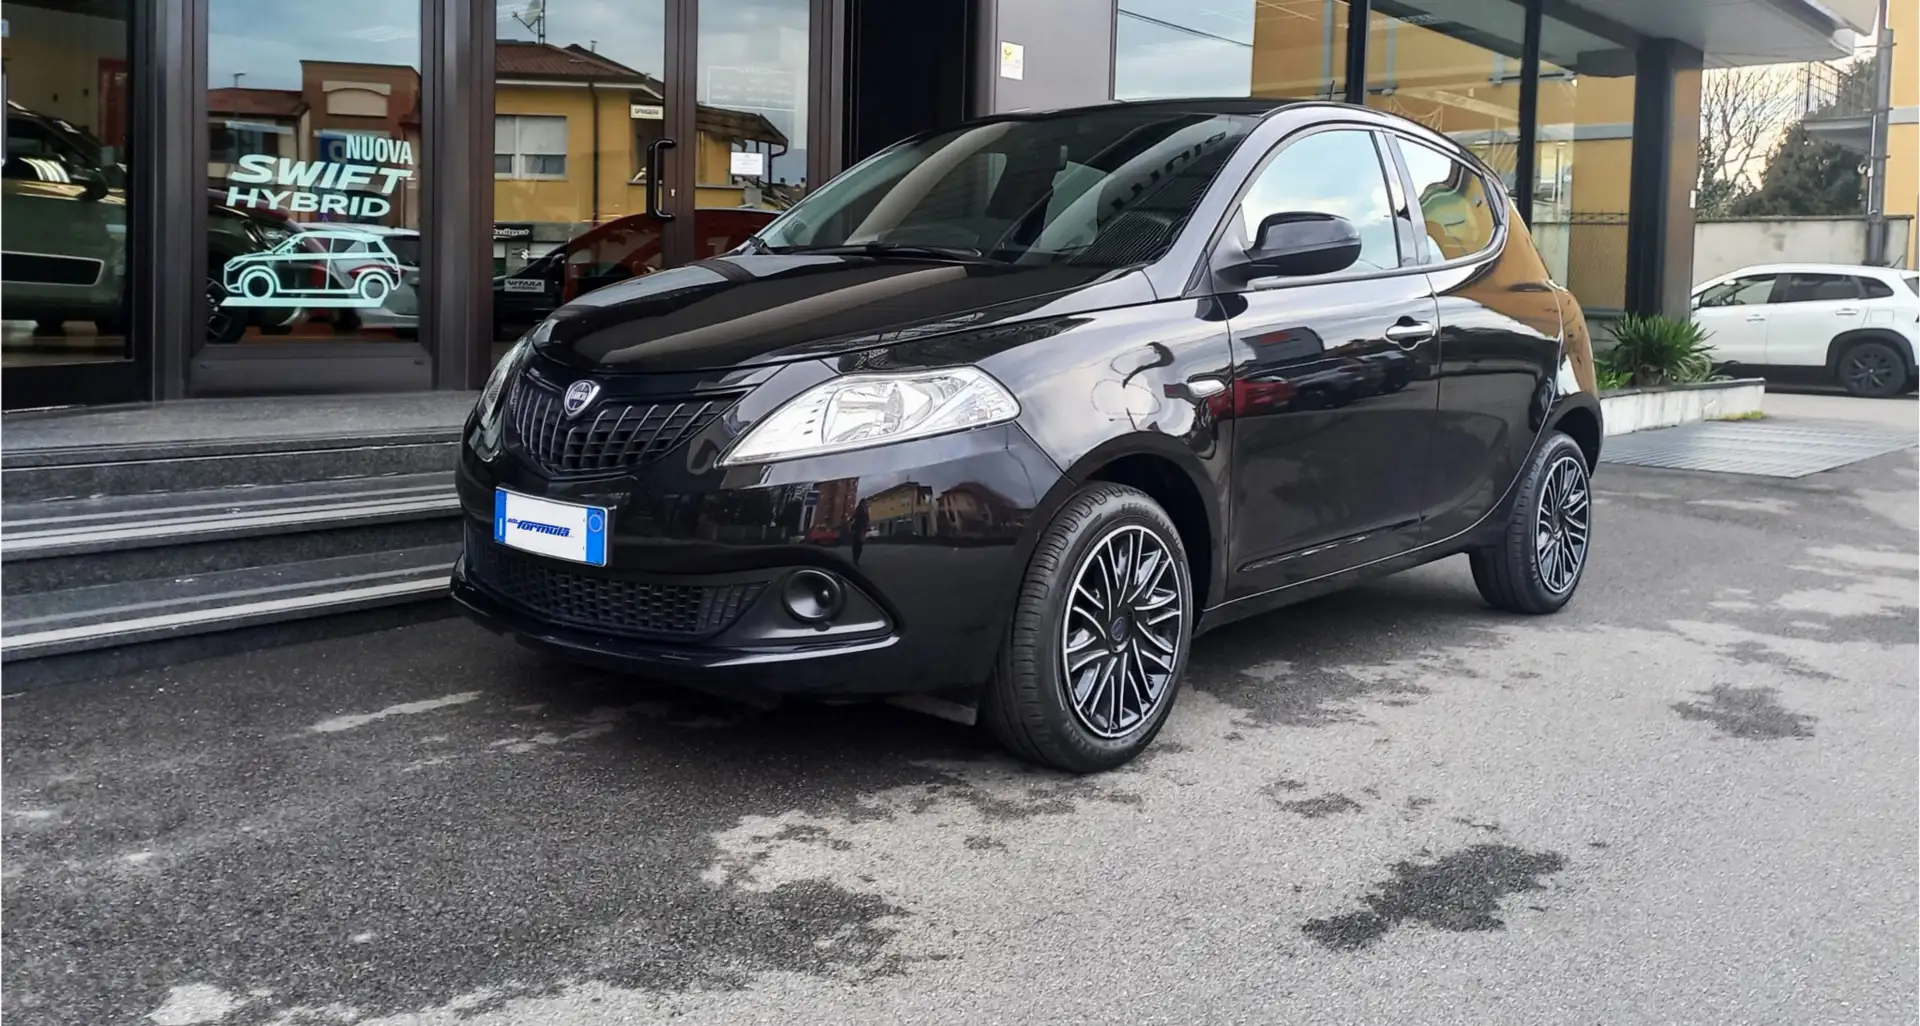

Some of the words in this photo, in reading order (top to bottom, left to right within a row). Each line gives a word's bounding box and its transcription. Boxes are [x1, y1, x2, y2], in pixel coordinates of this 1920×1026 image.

[347, 135, 413, 165] NUOVA
[230, 154, 412, 194] SWIFT
[226, 187, 390, 217] HYBRID
[517, 520, 570, 537] formula
